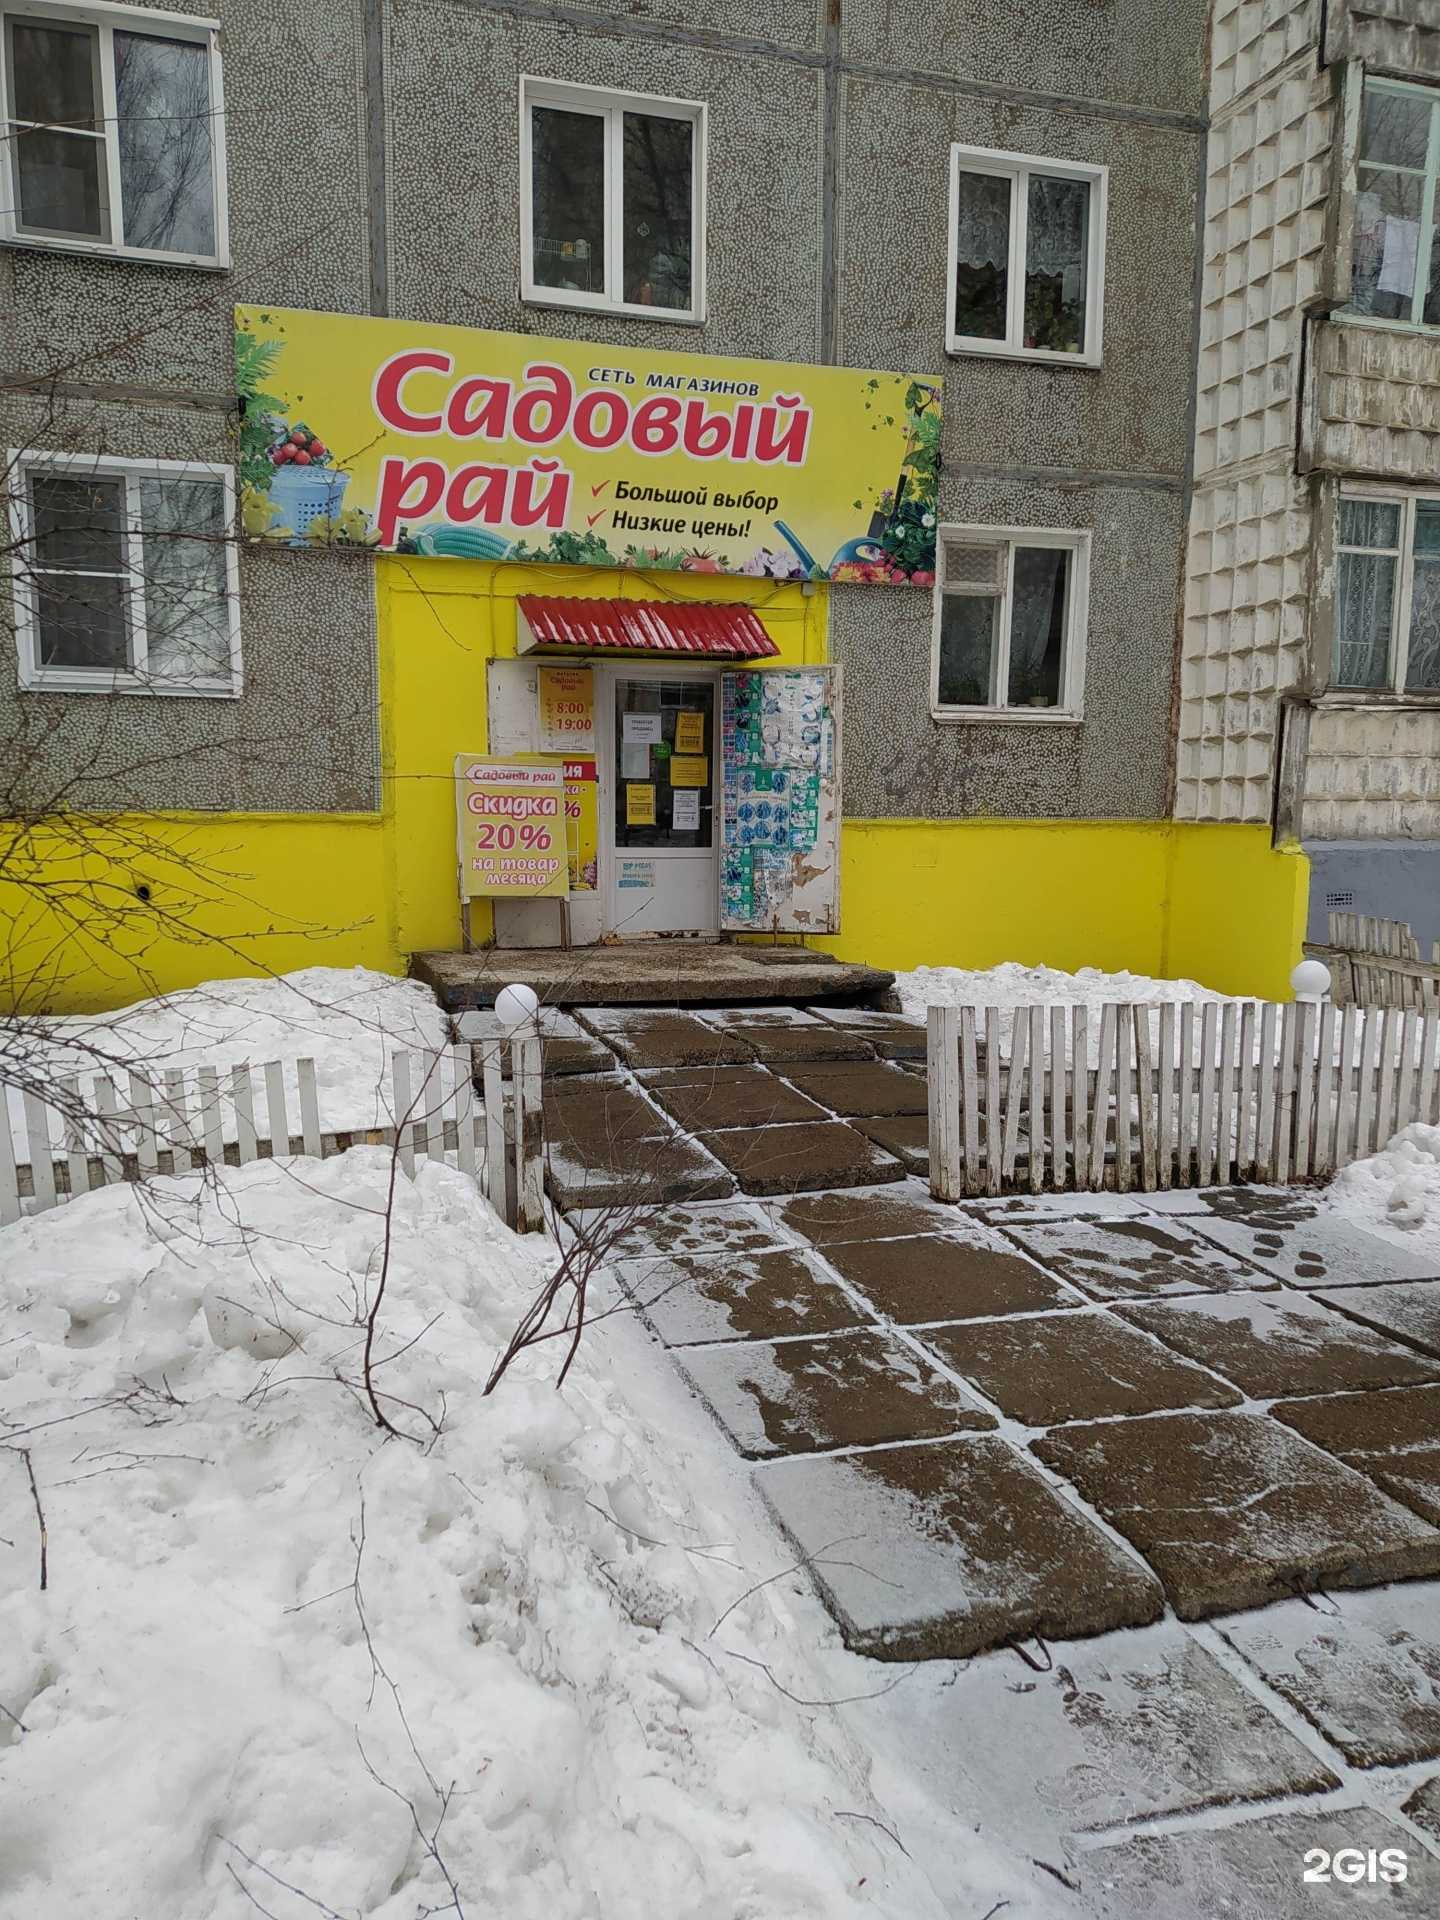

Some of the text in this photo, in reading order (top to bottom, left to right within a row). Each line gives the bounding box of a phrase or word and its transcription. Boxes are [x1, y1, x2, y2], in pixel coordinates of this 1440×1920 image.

[588, 367, 760, 397] СЕТЬ МАГАЗИНОВ
[374, 351, 810, 464] Садовый
[376, 458, 571, 547] рай
[615, 480, 779, 515] Большой выбор
[611, 509, 752, 539] Низкие цены!
[556, 702, 584, 714] 8:00
[556, 718, 592, 730] 19:00
[467, 791, 558, 821] Скидка
[477, 822, 552, 851] 20%
[472, 857, 560, 874] на товар
[486, 871, 547, 887] месяца
